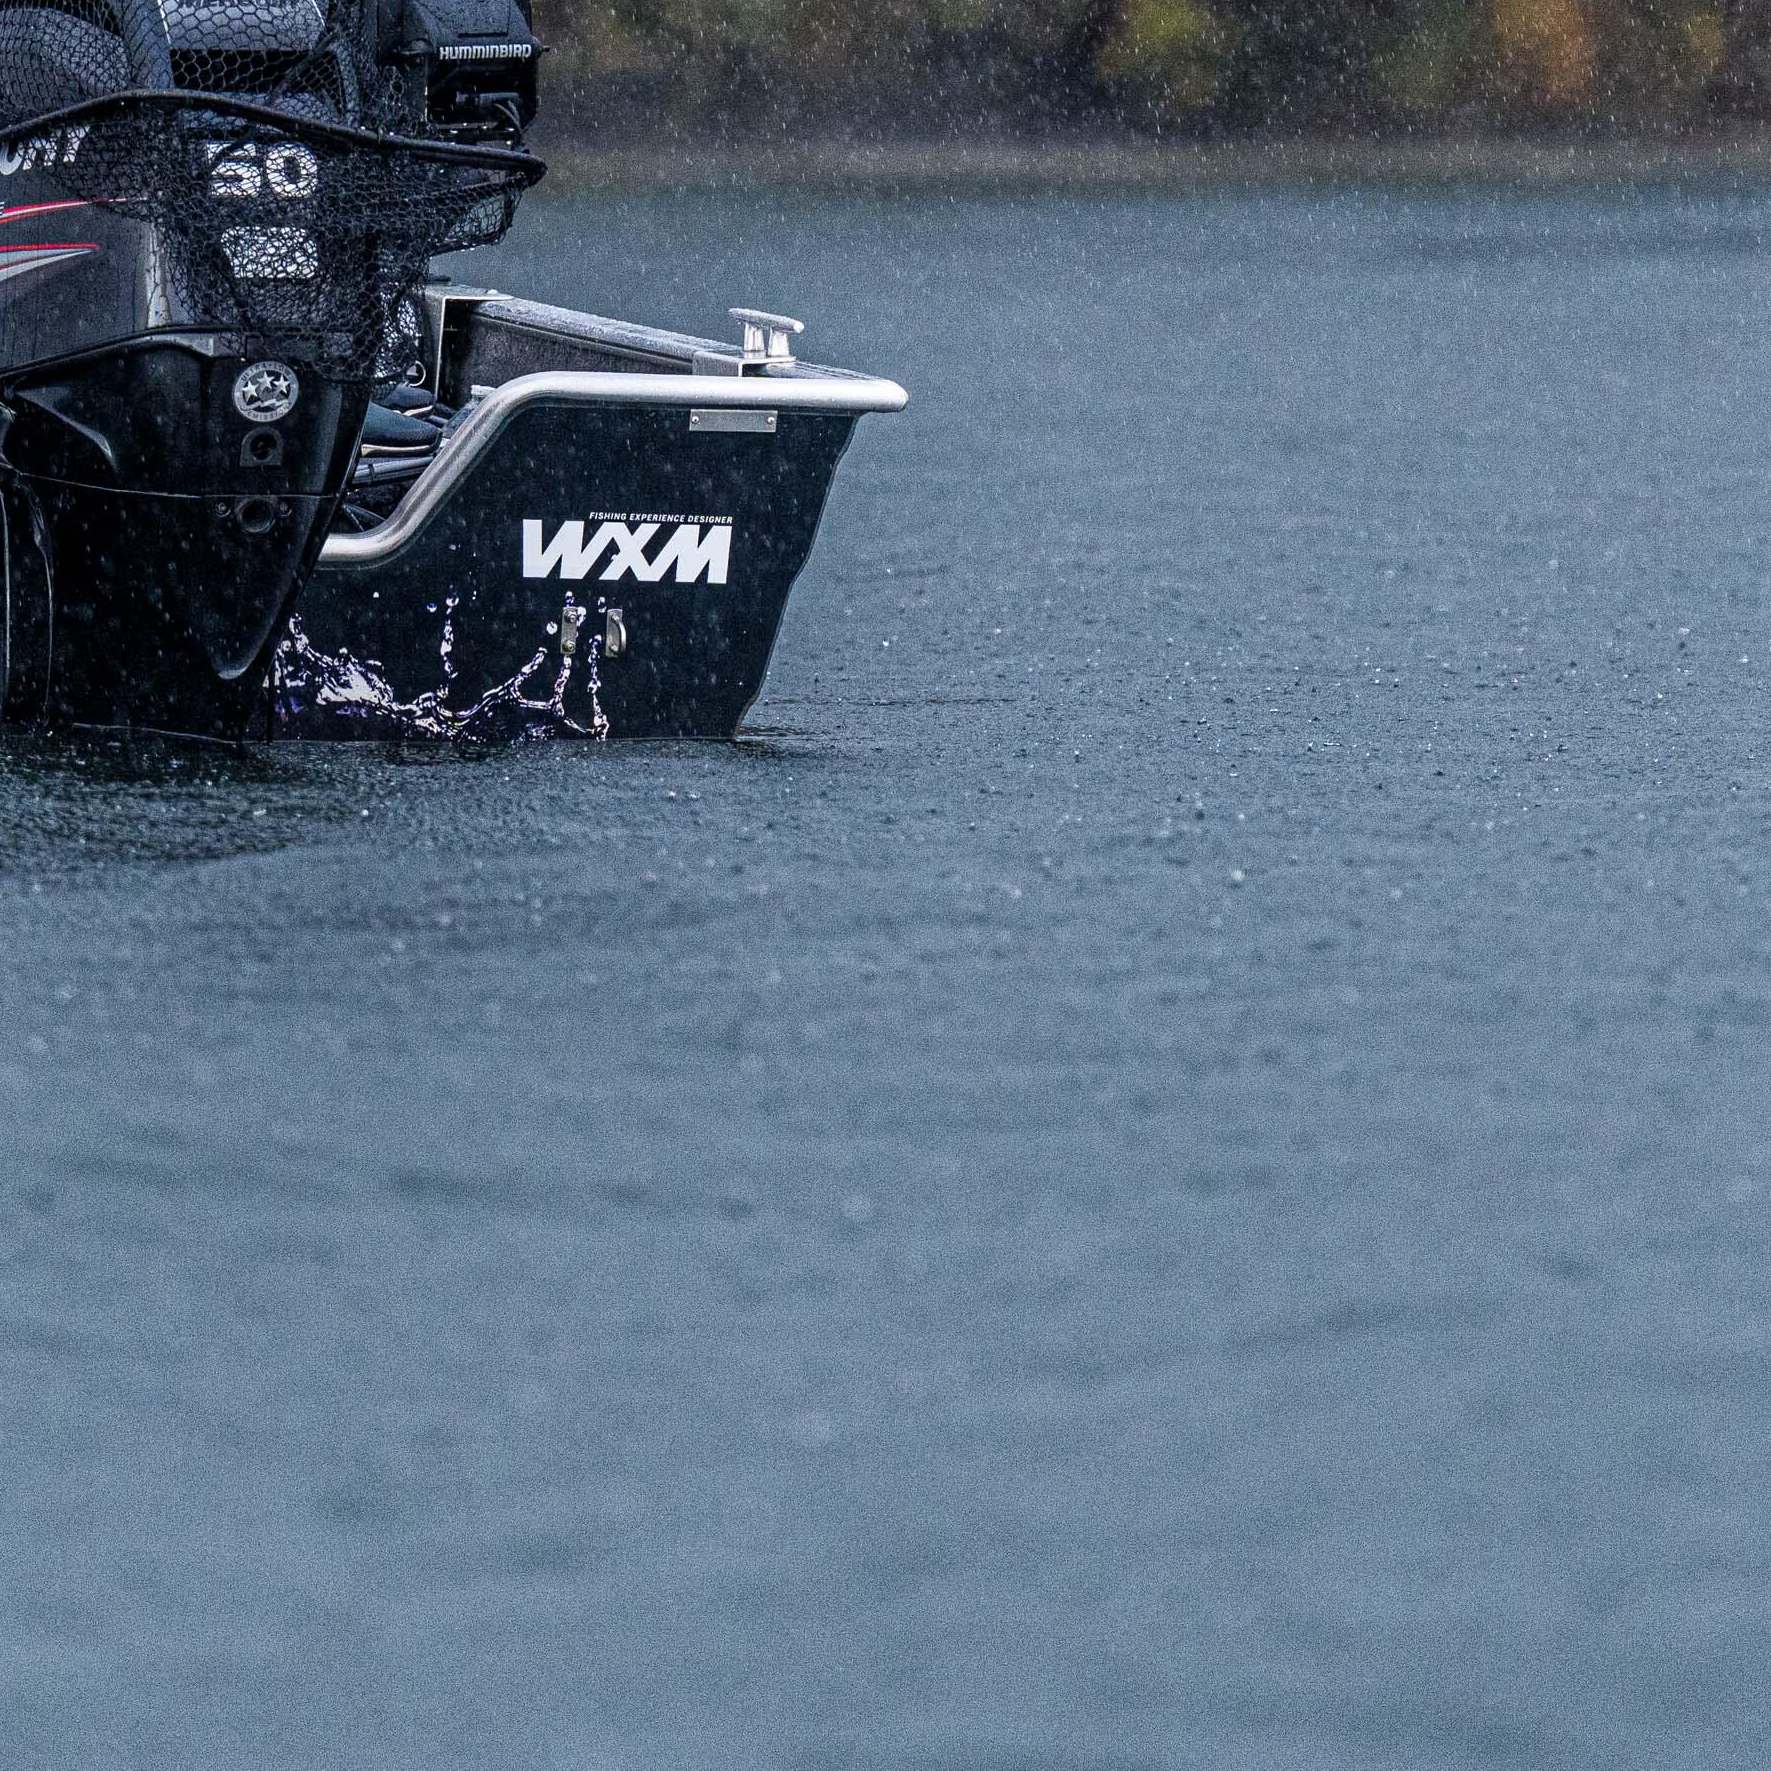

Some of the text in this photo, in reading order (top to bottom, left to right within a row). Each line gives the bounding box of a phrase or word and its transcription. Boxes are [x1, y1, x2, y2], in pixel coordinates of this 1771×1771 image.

[439, 44, 532, 61] HUMMINBIRD
[206, 142, 318, 197] 50
[589, 511, 733, 524] FISHING EXPERIENCE DESIGNER
[522, 518, 733, 584] WXM
